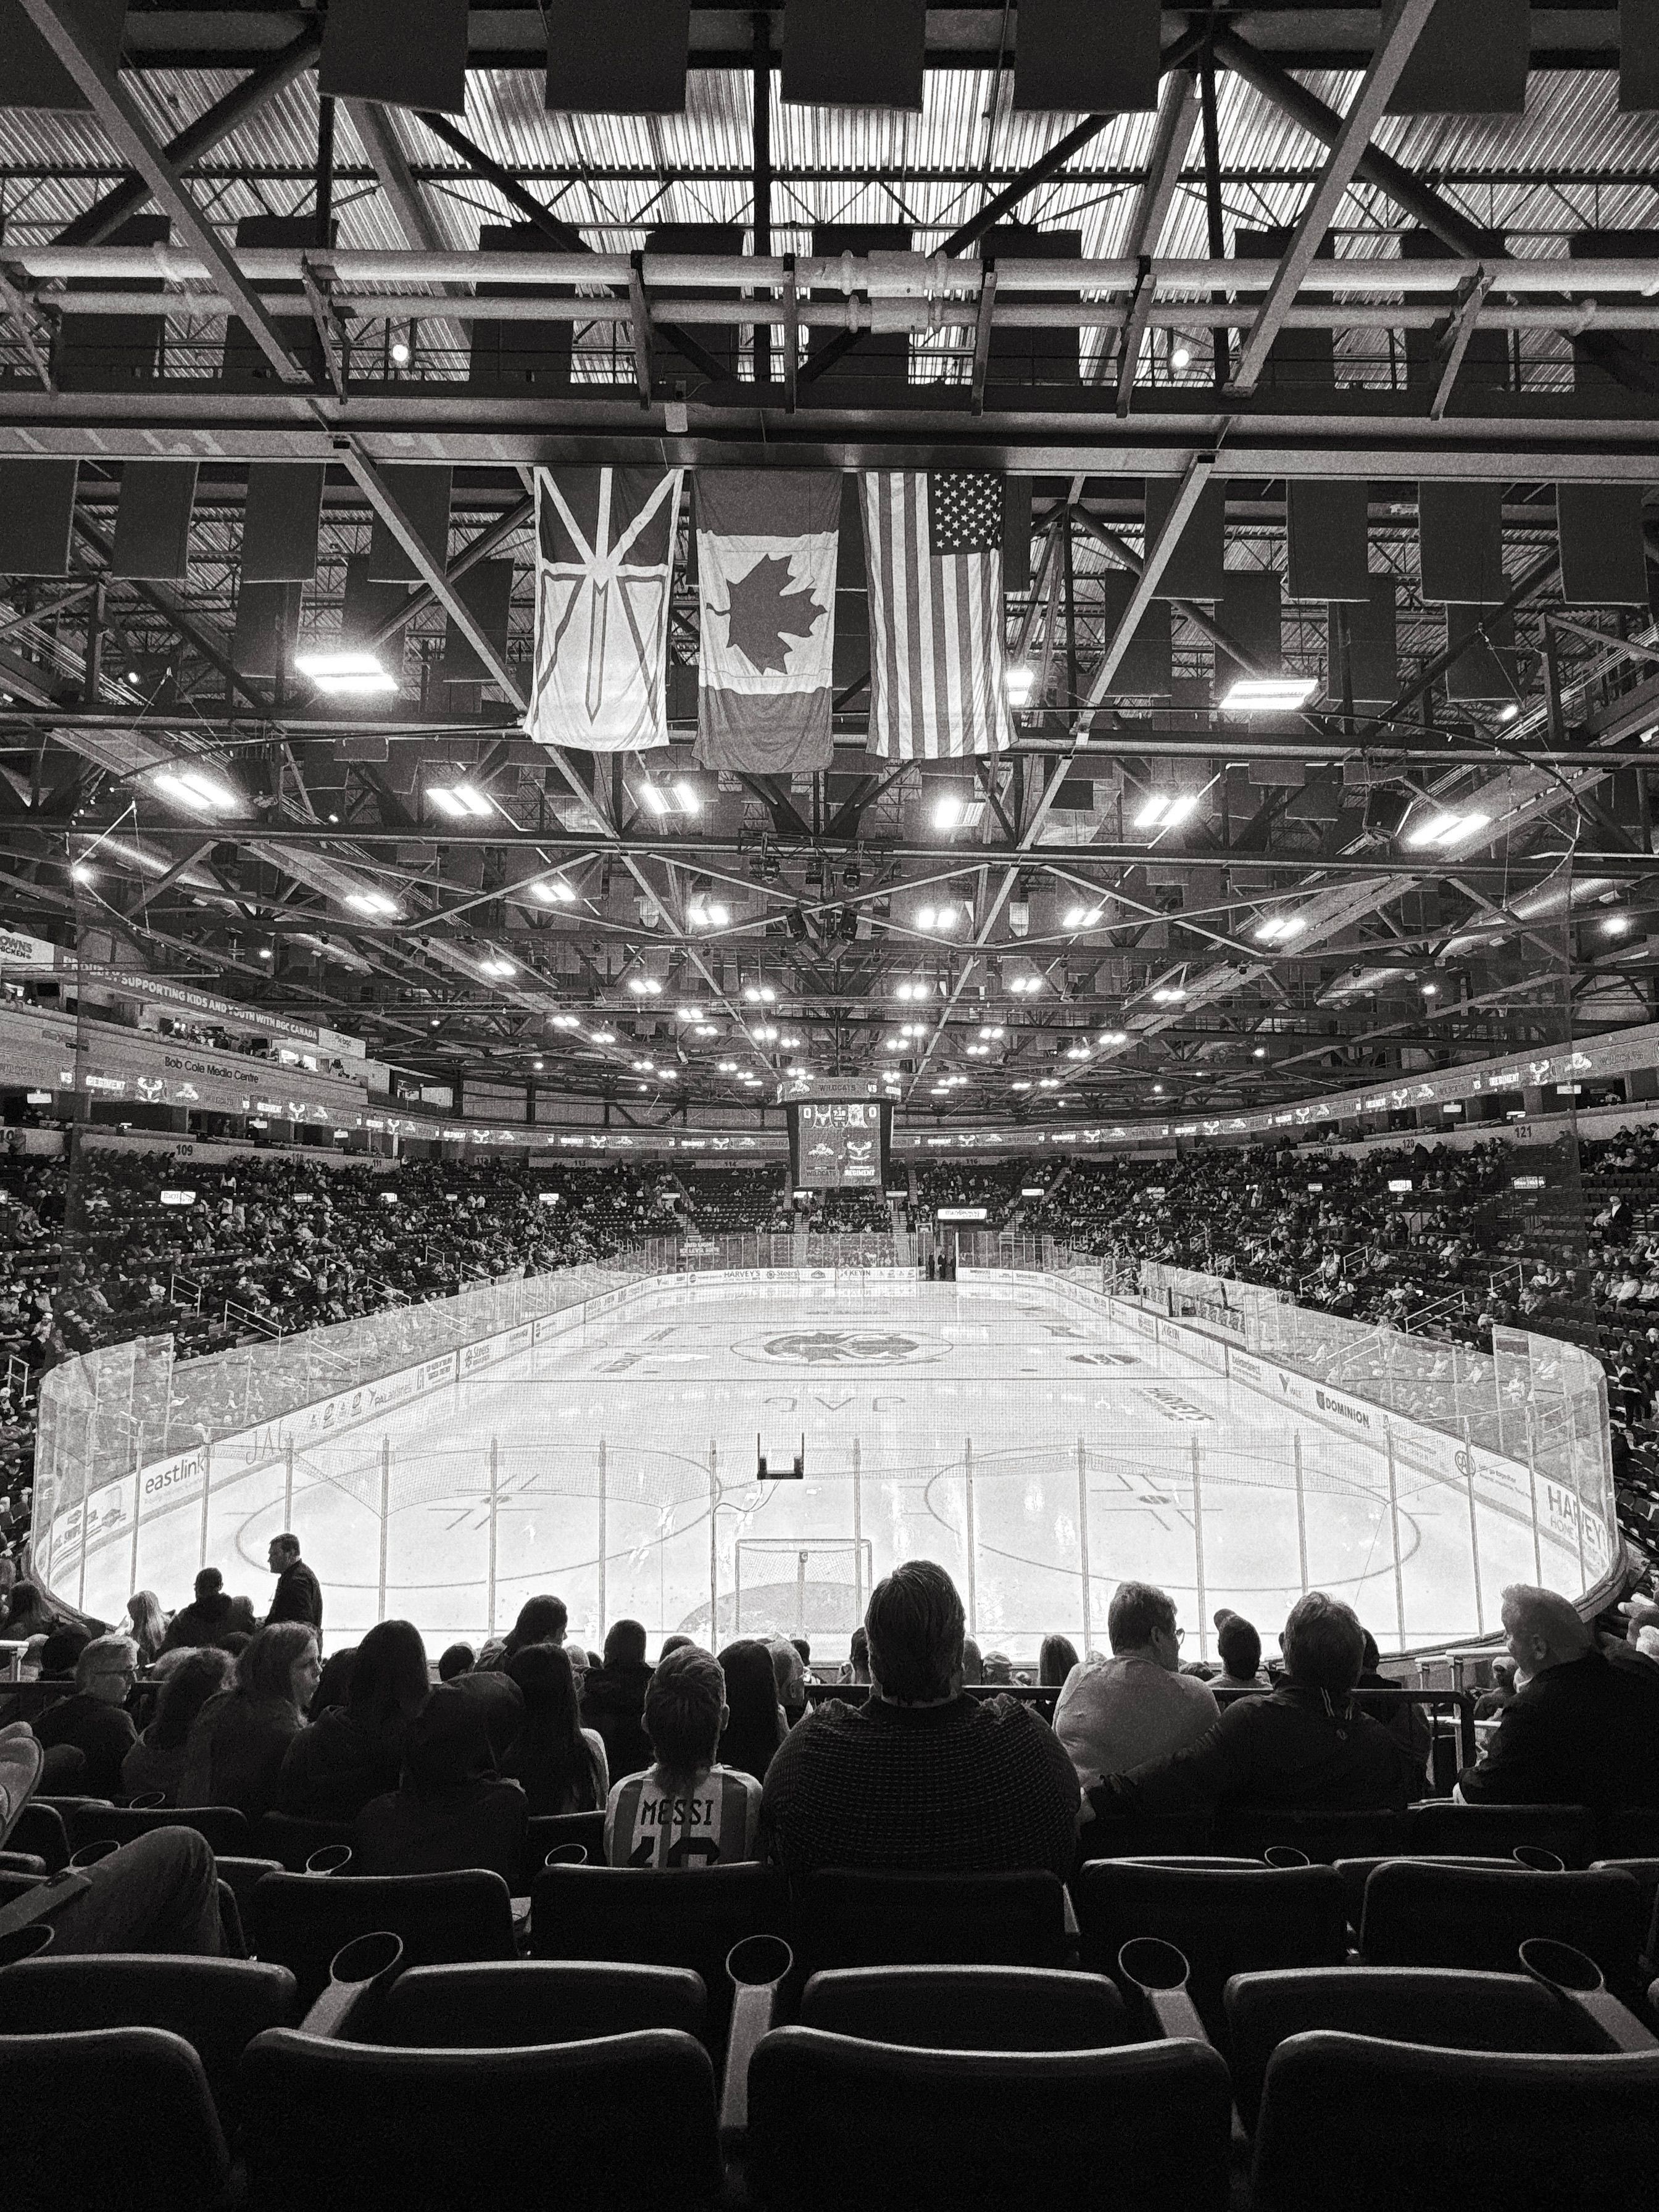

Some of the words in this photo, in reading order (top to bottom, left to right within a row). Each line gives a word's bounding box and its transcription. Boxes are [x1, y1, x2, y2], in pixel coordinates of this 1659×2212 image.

[121, 976, 186, 1002] SUPPORTING
[186, 992, 208, 1008] KIDS
[209, 999, 227, 1013] AND
[256, 1012, 275, 1028] WITH
[276, 1019, 290, 1032] BGC
[290, 1024, 317, 1039] CANADA
[165, 1056, 183, 1070] Bob
[185, 1060, 205, 1073] Cole
[207, 1064, 233, 1079] Media
[234, 1070, 259, 1084] Centre
[820, 1084, 857, 1092] WILDCATS
[867, 1084, 878, 1093] VS
[803, 1107, 812, 1119] 0
[868, 1107, 877, 1118] 0
[1515, 1126, 1532, 1138] 121
[1402, 1139, 1415, 1149] 120
[177, 1144, 193, 1157] 109
[373, 1159, 382, 1168] 111
[723, 1270, 760, 1278] HARVEY'S
[1326, 1397, 1370, 1426] DOMINION
[145, 1452, 204, 1494] eastlink
[641, 1798, 714, 1826] MESSI
